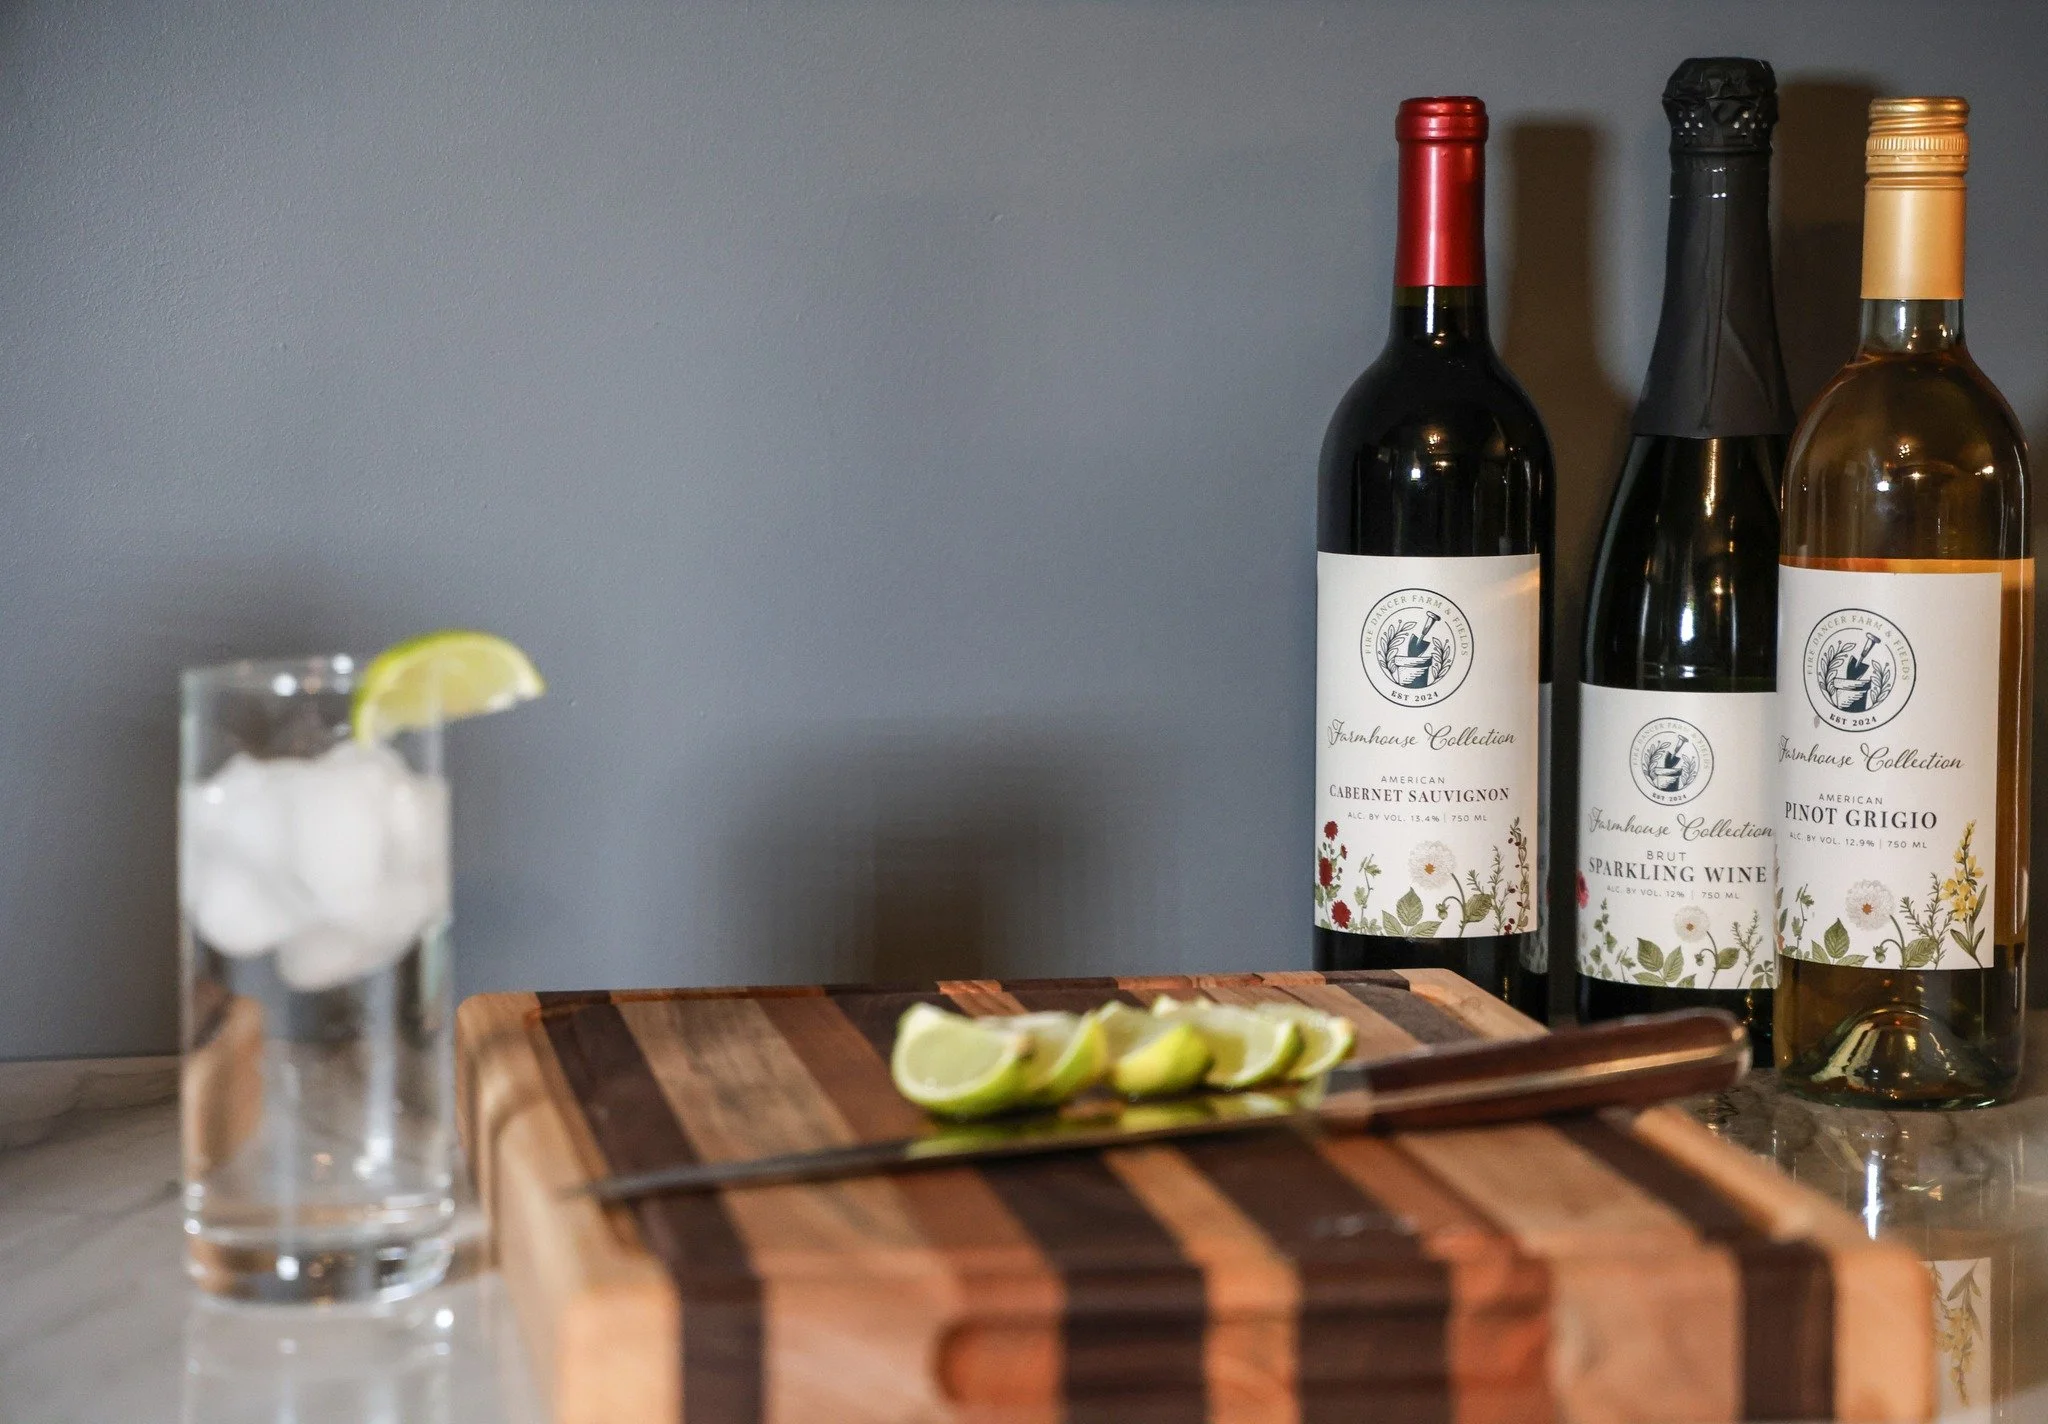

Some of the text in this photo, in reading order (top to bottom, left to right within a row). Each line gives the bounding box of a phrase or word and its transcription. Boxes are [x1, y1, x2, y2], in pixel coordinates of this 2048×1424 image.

[1370, 596, 1407, 626] DANCER
[1412, 595, 1442, 608] FARM
[1452, 618, 1468, 656] FIELDS
[1812, 616, 1847, 646] DANCER
[1852, 615, 1884, 630] FARM
[1894, 640, 1911, 680] FIELDS
[1391, 690, 1438, 702] EST 2024
[1830, 713, 1877, 726] EST 2024
[1328, 718, 1518, 750] Farmhouse Collection
[1778, 735, 1965, 772] Farmhouse Collection
[1381, 775, 1446, 784] AMERICAN
[1329, 784, 1510, 804] CABERNET SAUVIGNON
[1818, 793, 1884, 805] AMERICAN
[1348, 812, 1365, 820] ALC.
[1369, 813, 1380, 821] BY
[1384, 814, 1406, 822] VOL.
[1452, 814, 1470, 822] 750
[1588, 807, 1774, 842] Farmhouse Collection
[1785, 801, 1938, 830] PINOT GRIGIO
[1790, 832, 1928, 849] ALC. BY VOL. 12.9% 750 ML
[1646, 850, 1687, 862] BRUT
[1588, 857, 1767, 883] SPARKLING WINE
[1641, 888, 1662, 897] VOL.
[1666, 890, 1684, 898] 12%
